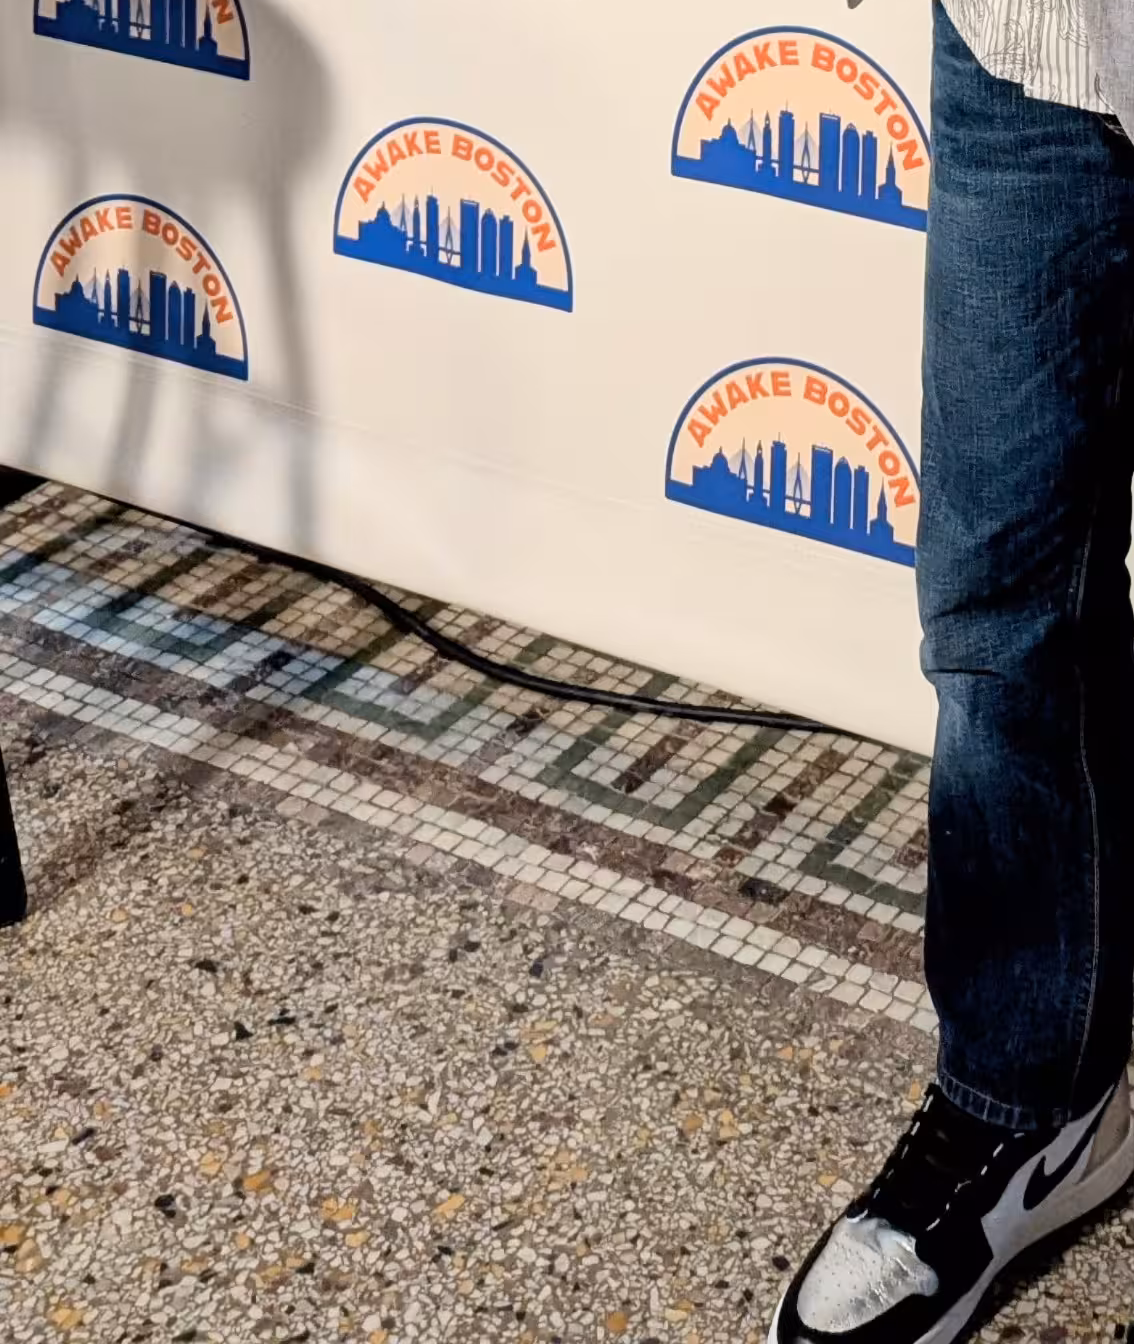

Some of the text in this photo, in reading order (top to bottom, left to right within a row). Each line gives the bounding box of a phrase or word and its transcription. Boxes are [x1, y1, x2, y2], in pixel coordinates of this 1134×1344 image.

[695, 40, 925, 171] AWAKE BOSTON
[353, 130, 557, 253] AWAKE BOSTON
[51, 206, 233, 325] AWAKE BOSTON
[687, 370, 916, 508] AWAKE BOSTON
